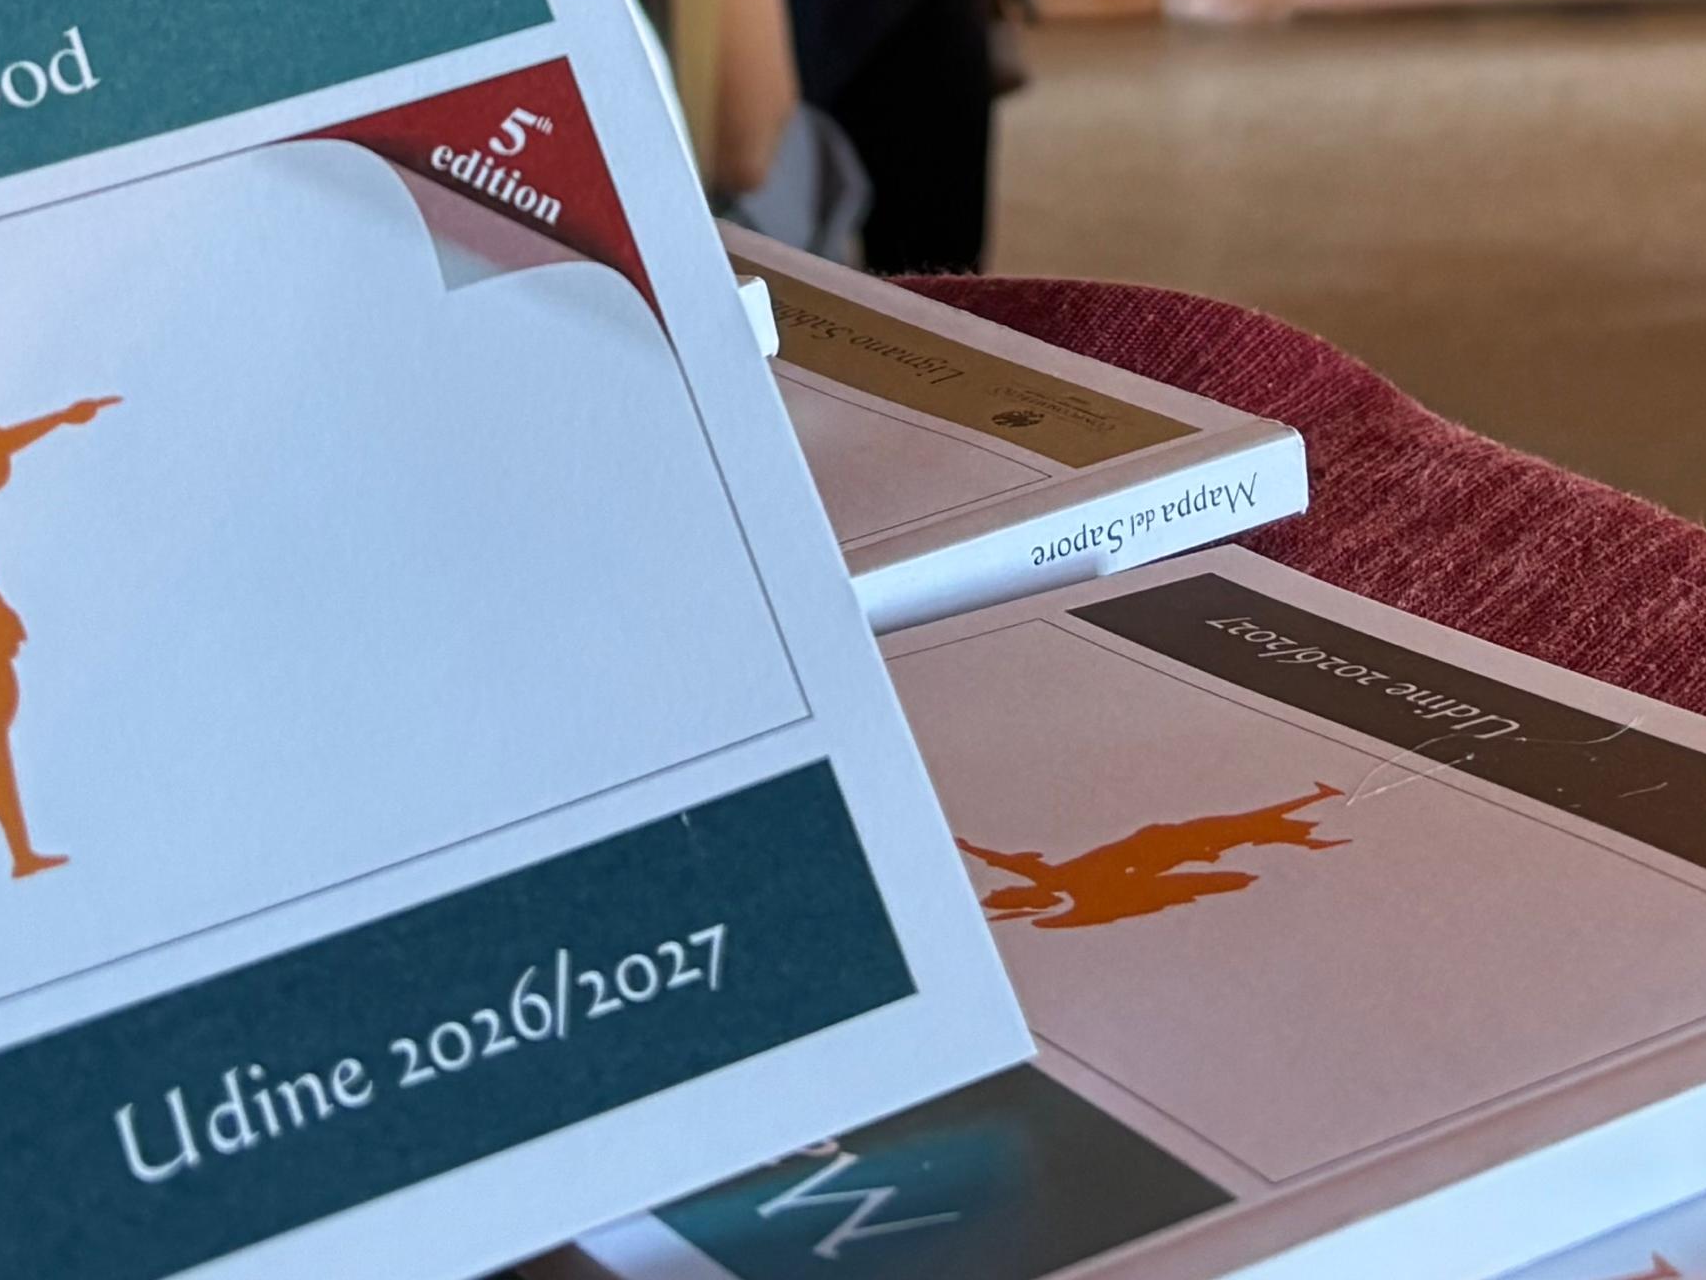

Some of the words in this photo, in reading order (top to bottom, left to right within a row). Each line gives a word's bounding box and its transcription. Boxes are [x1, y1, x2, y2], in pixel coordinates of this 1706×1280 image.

[429, 144, 562, 227] edition
[849, 333, 965, 385] Lignano
[1129, 509, 1156, 536] del
[1161, 471, 1258, 523] Mappa
[1030, 518, 1123, 566] Sapore
[1204, 616, 1390, 686] 2026/2027
[1384, 682, 1521, 740] Udine
[113, 1055, 374, 1184] Udine
[389, 922, 727, 1088] 2026/2027
